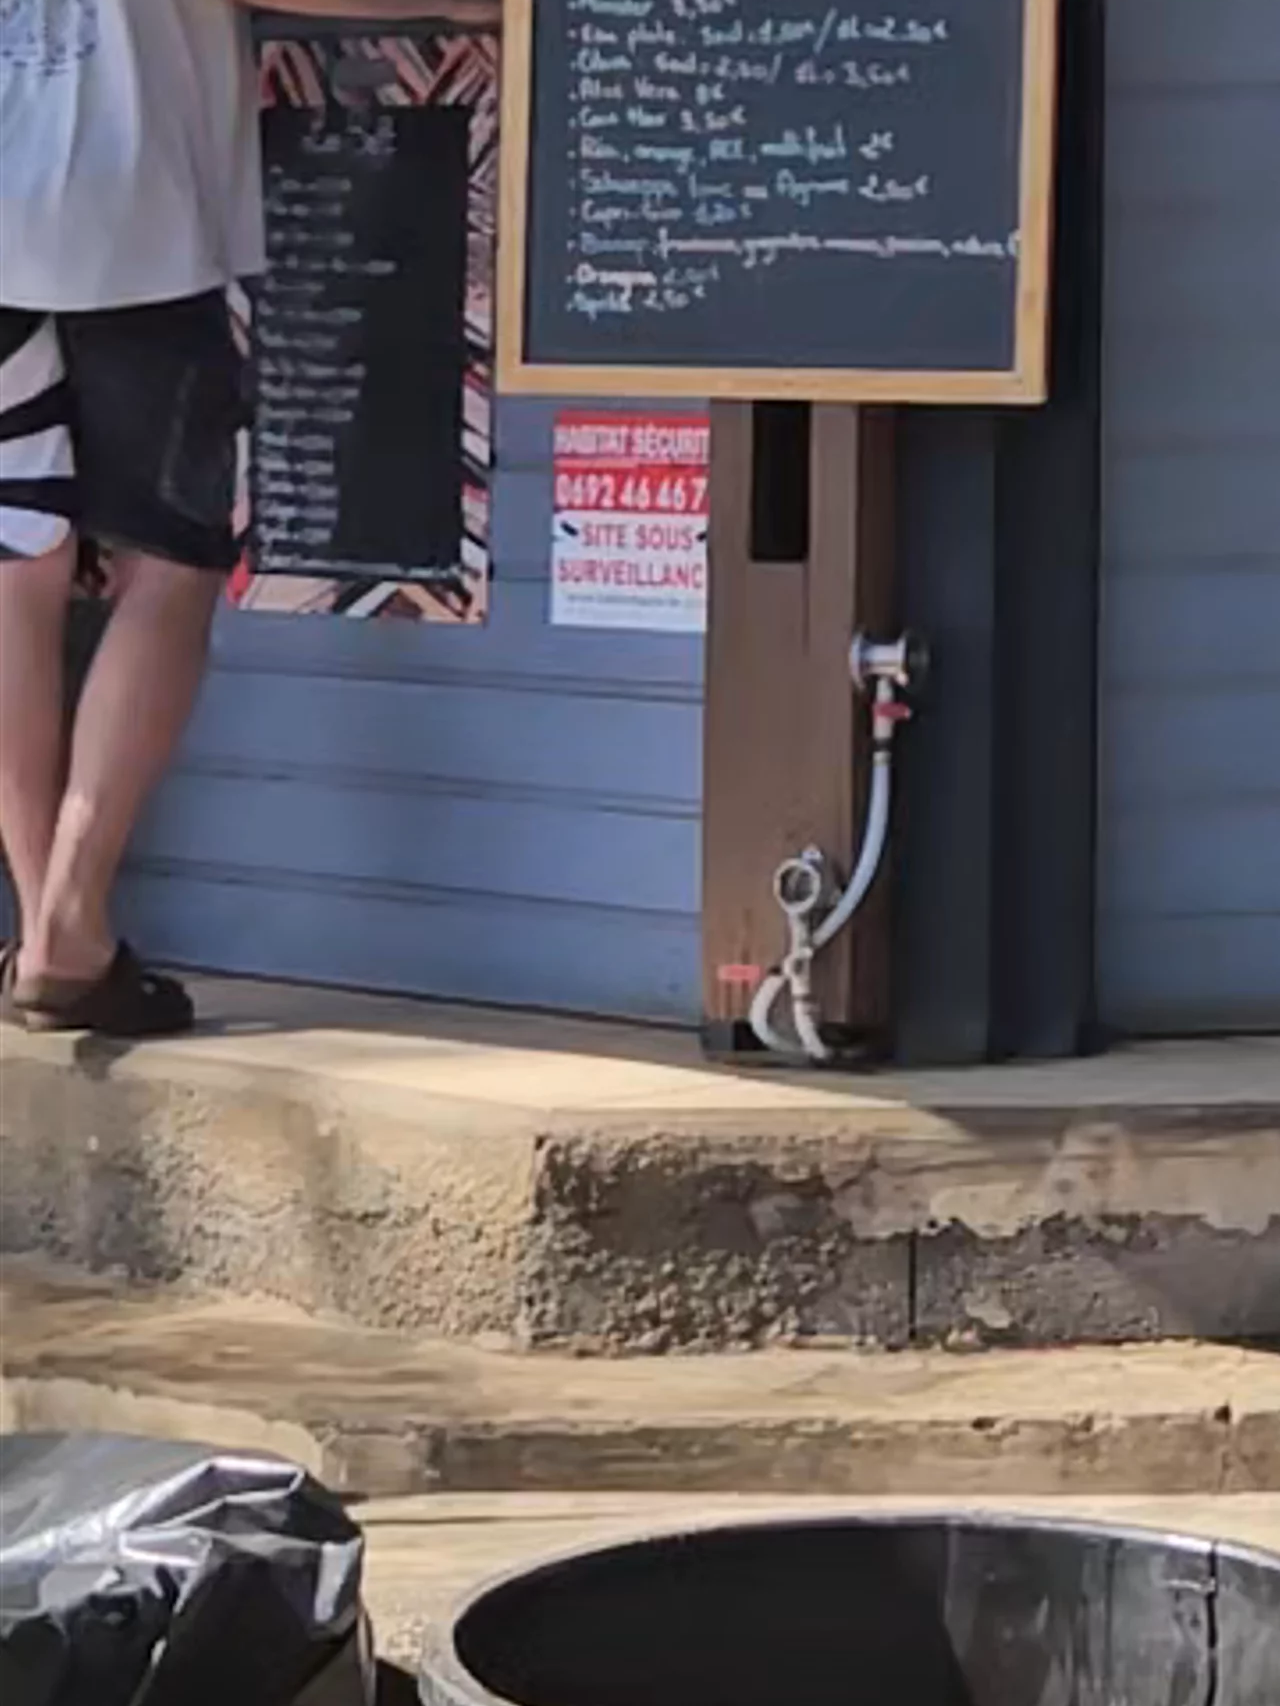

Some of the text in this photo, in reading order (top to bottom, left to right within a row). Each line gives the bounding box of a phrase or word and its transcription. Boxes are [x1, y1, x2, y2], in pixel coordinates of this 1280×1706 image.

[631, 422, 710, 464] SÉCURIT
[556, 473, 615, 507] 0692
[691, 477, 709, 511] 7
[582, 523, 694, 551] SITE SOUS
[558, 558, 704, 589] SURVEILLANC
